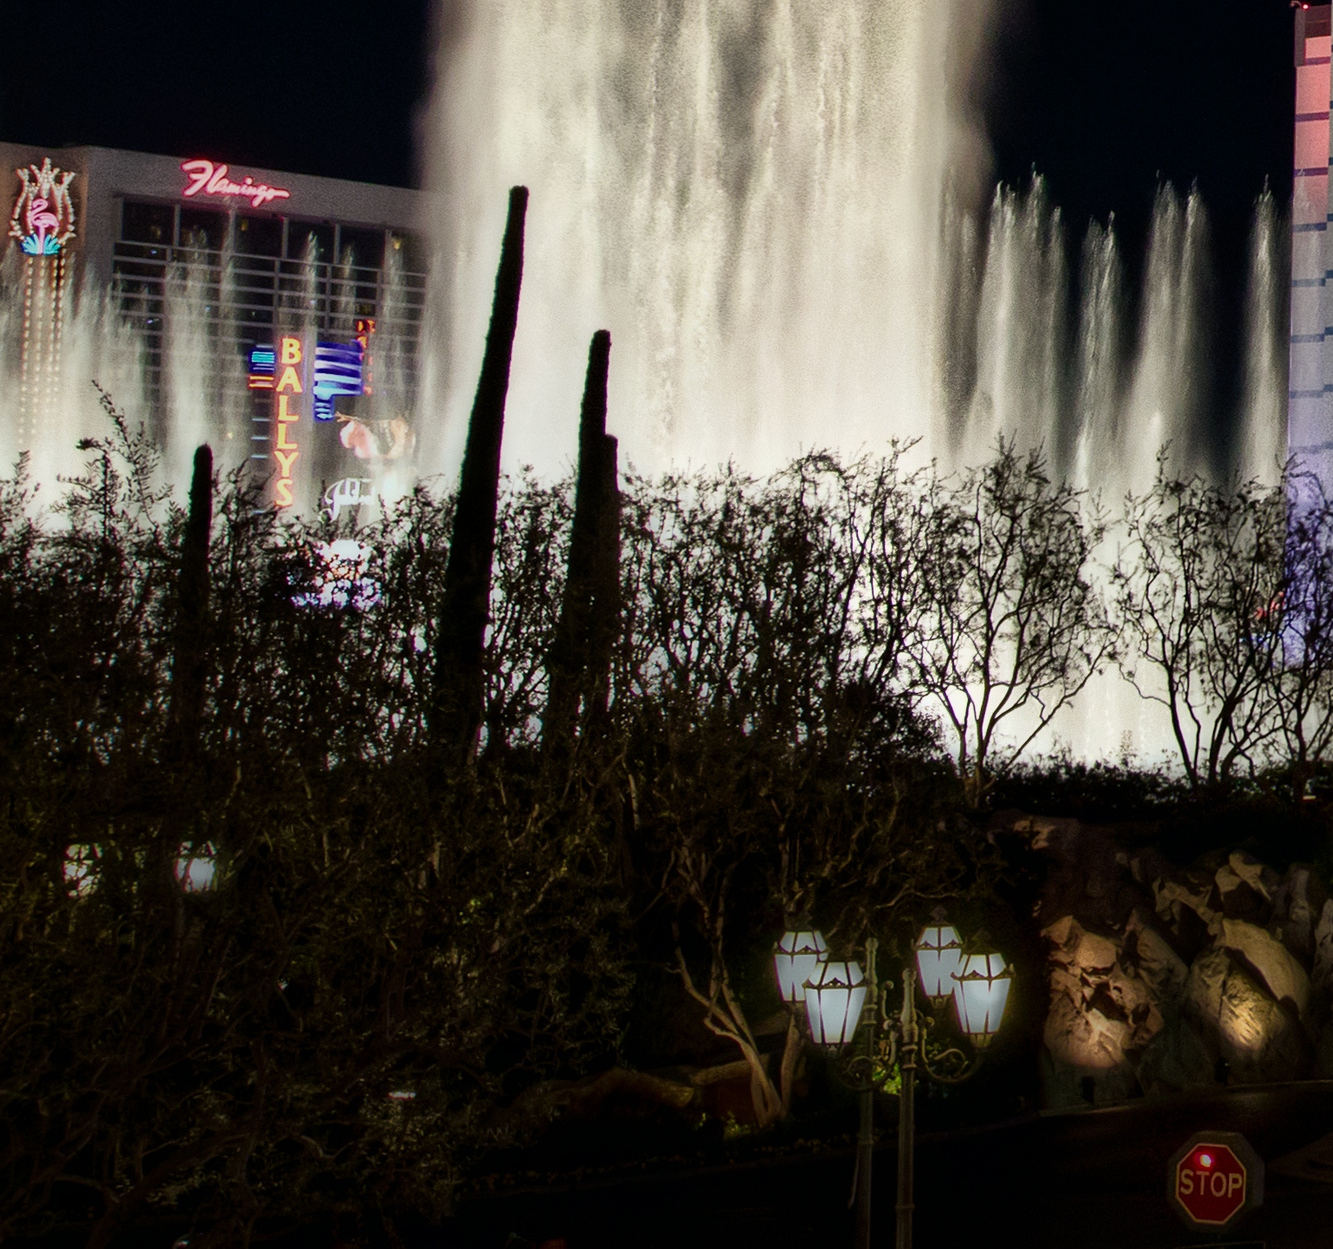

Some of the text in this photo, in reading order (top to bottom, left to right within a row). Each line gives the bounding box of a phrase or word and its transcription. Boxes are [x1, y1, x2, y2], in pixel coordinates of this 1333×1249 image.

[181, 159, 290, 208] Flamingo
[274, 337, 303, 507] BALLYS
[1180, 1168, 1243, 1198] STOP
